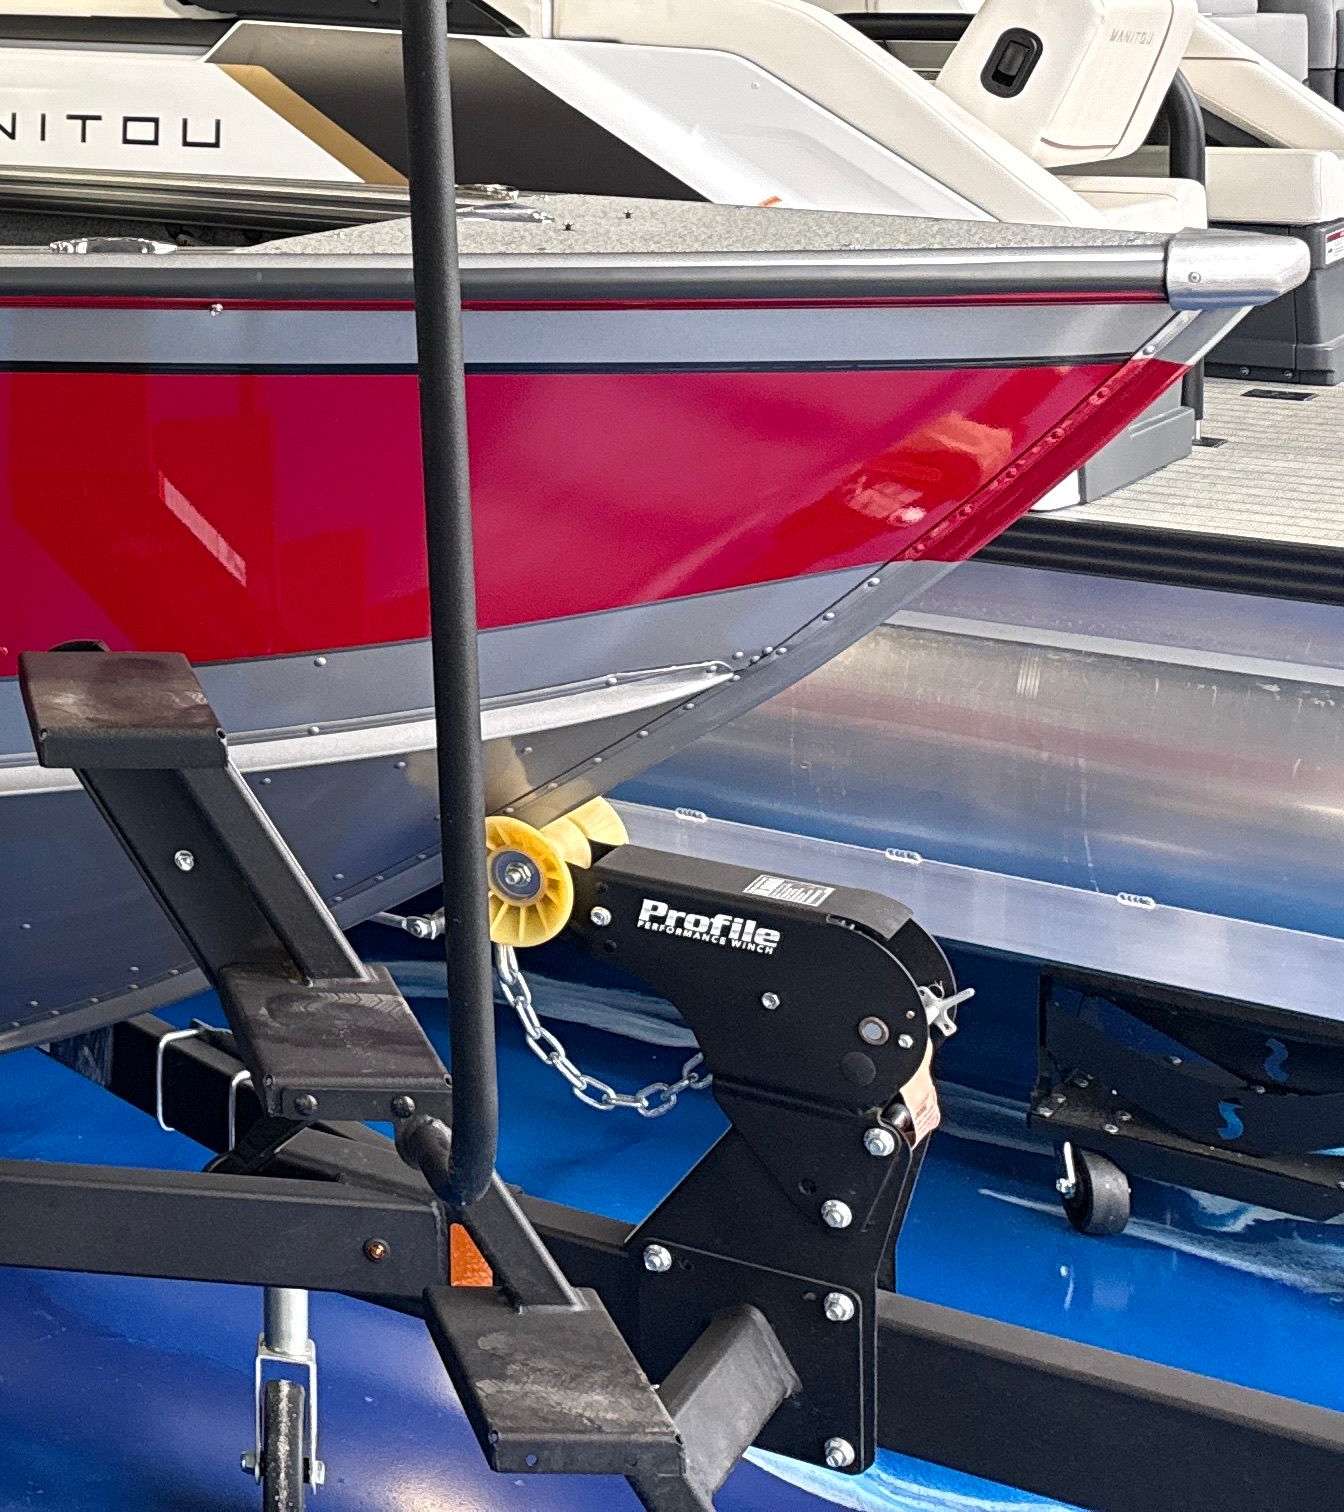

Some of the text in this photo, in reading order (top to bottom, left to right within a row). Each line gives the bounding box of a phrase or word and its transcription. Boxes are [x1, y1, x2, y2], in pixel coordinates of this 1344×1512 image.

[636, 919, 775, 955] PERFORMANCE WINCH
[638, 898, 781, 948] Profile
